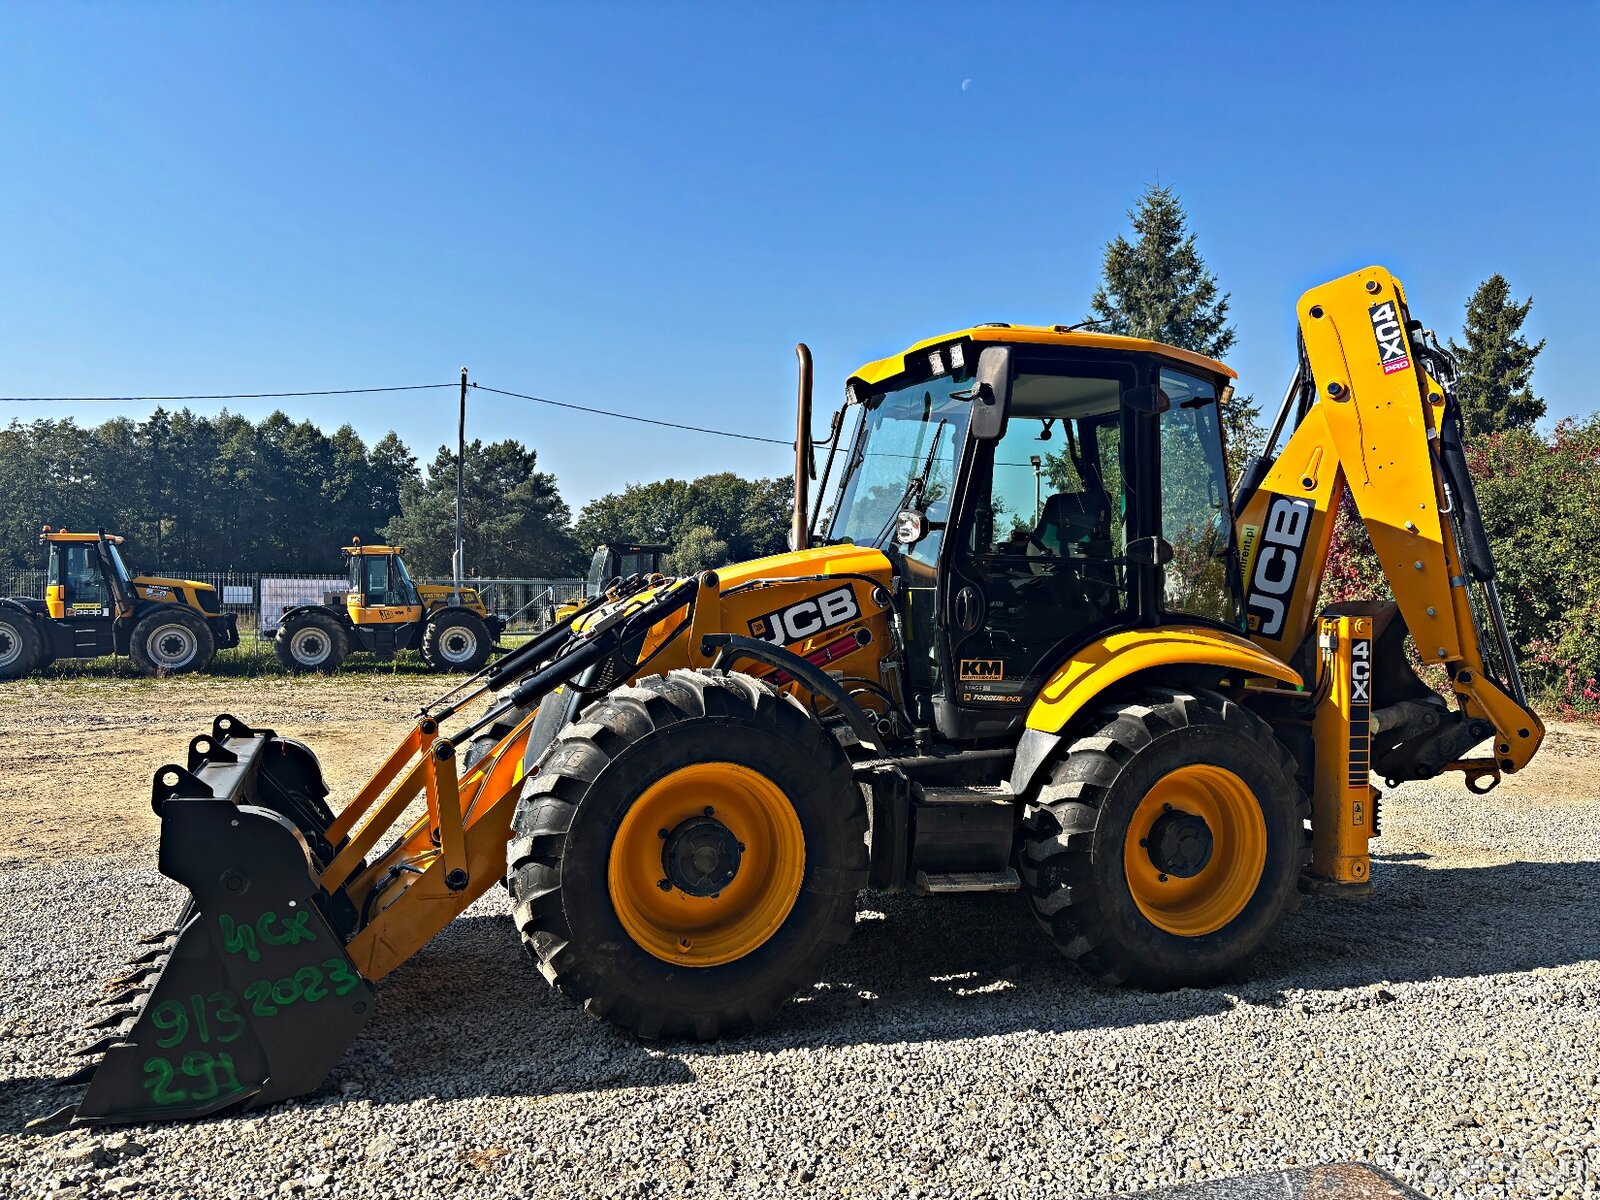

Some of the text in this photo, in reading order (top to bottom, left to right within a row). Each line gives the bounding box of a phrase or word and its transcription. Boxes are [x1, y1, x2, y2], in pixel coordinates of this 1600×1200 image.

[1372, 303, 1406, 360] 4CX
[1385, 360, 1409, 373] PRO
[1239, 527, 1255, 578] mrent.pl
[1249, 499, 1309, 635] JCB
[758, 588, 858, 647] JCB
[962, 662, 1001, 676] KM
[1352, 641, 1369, 699] 4CX
[244, 958, 358, 1017] 2023
